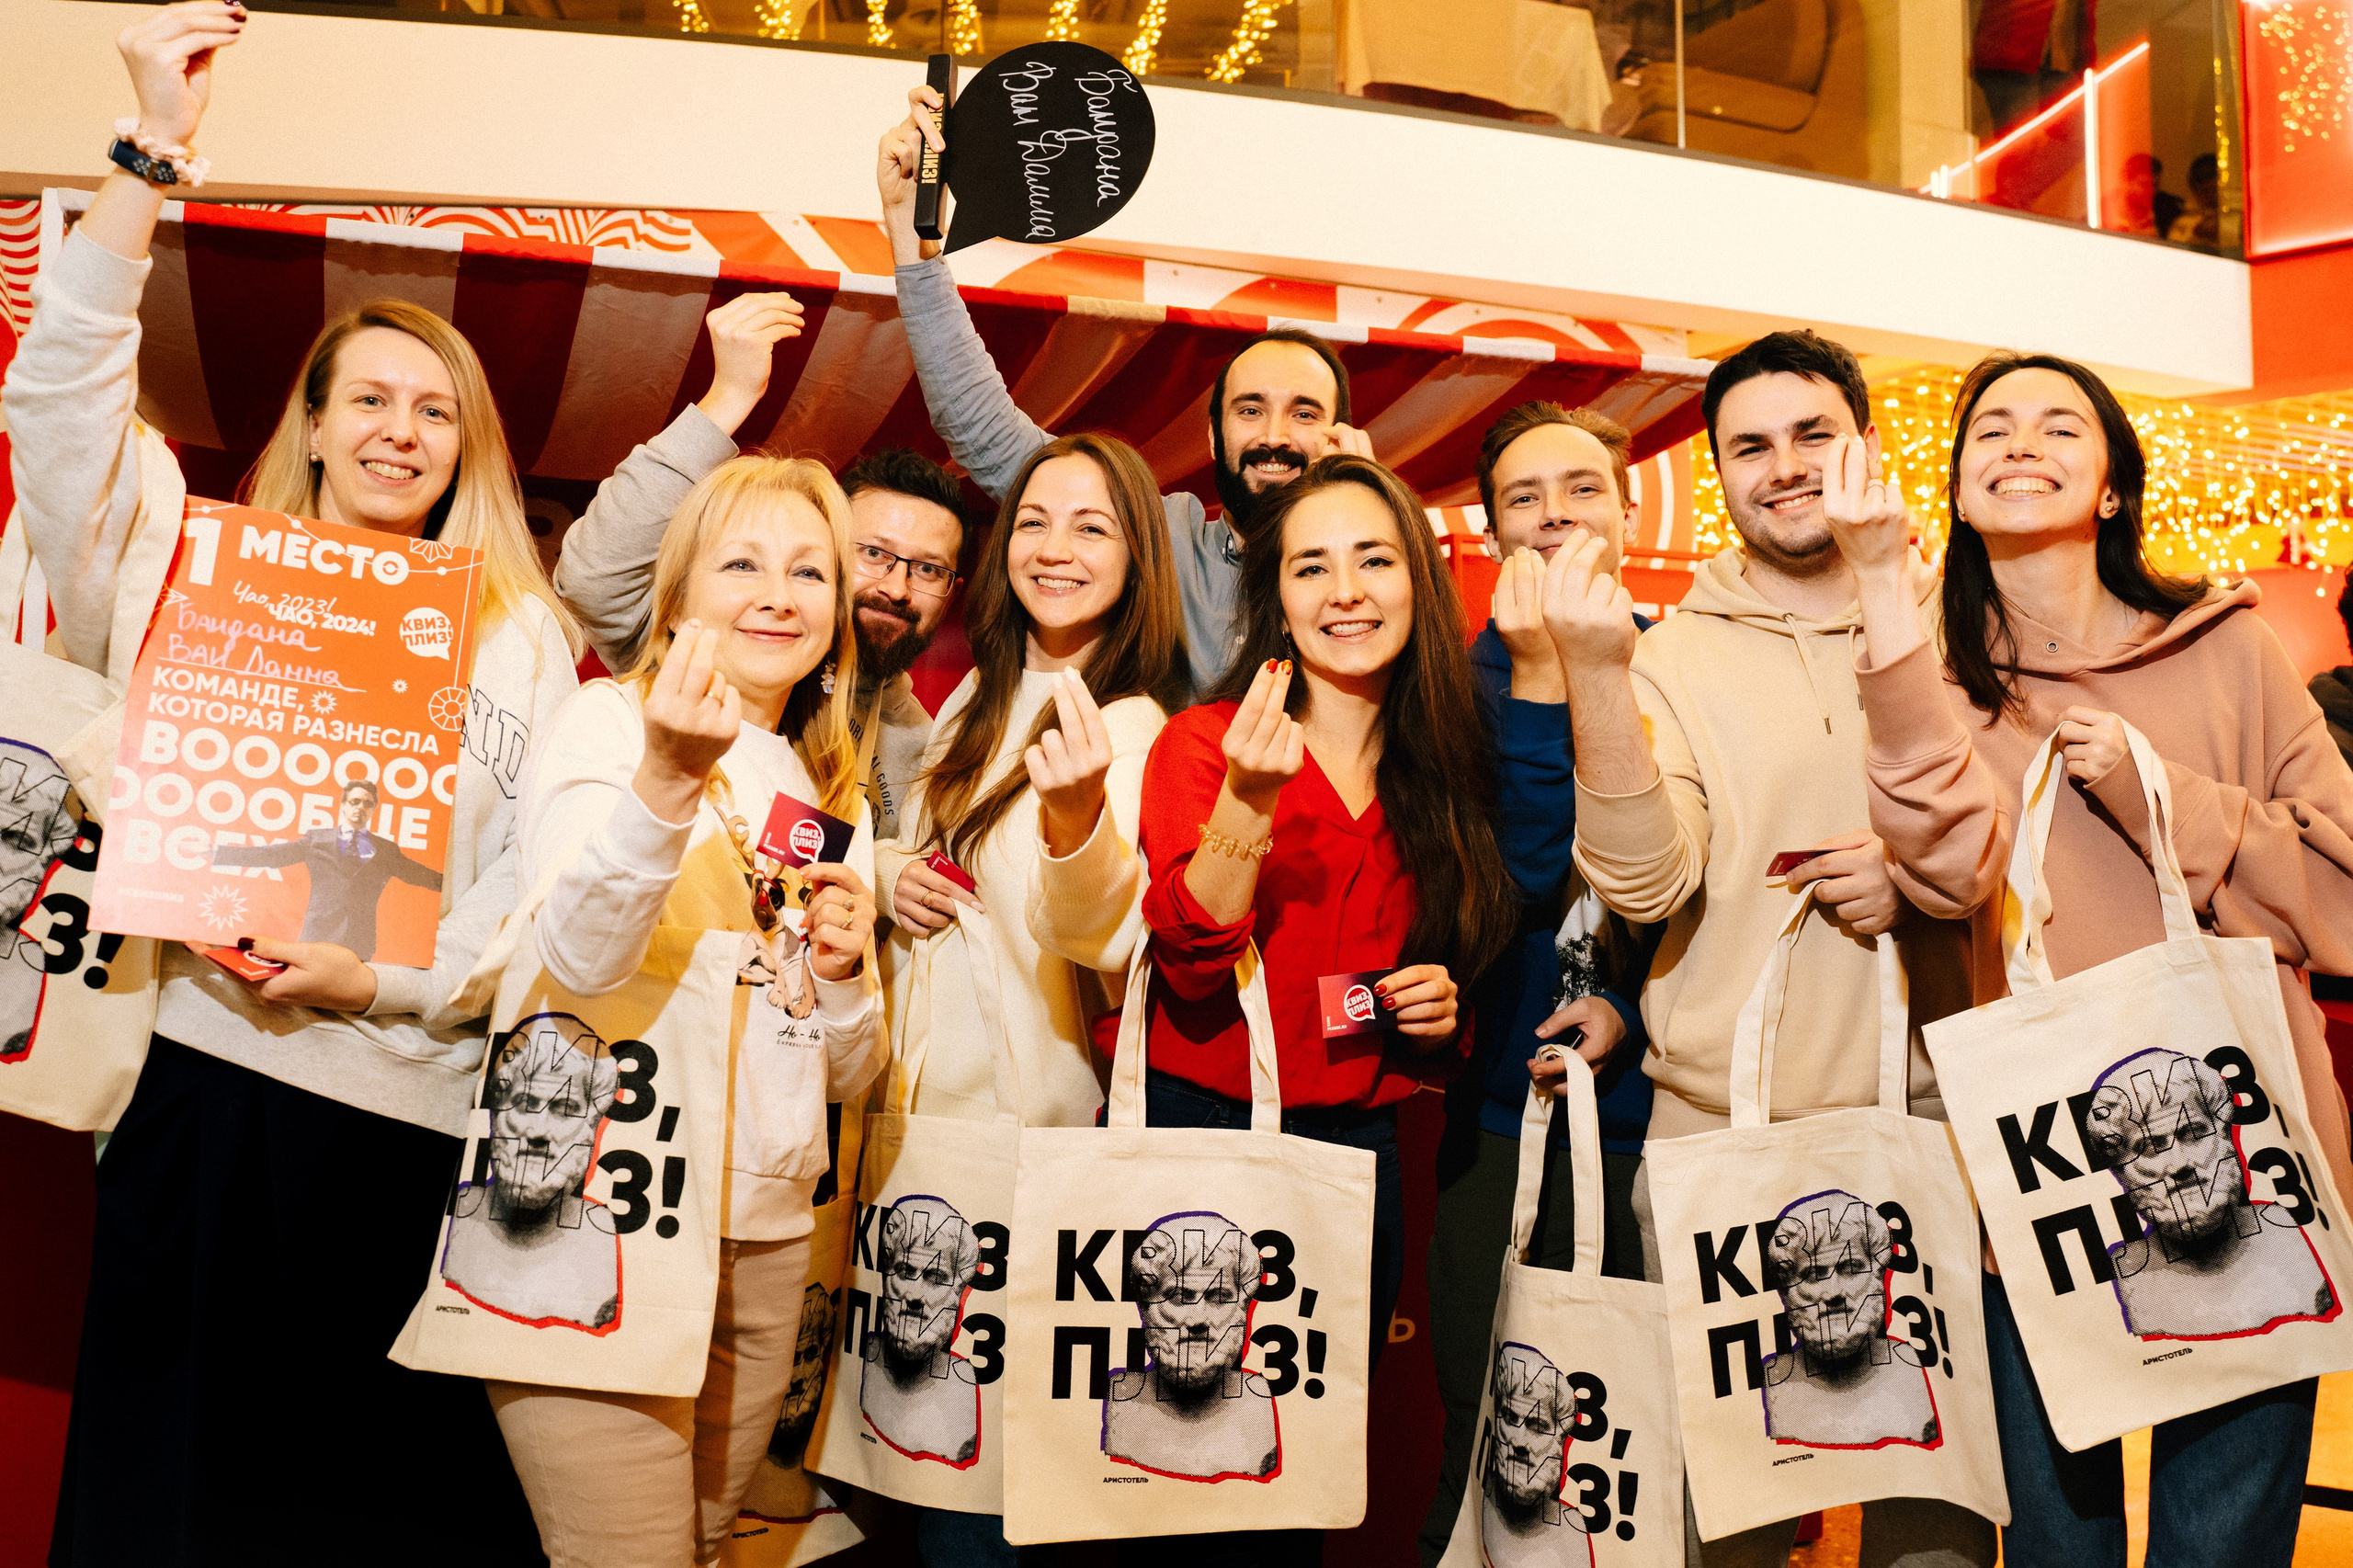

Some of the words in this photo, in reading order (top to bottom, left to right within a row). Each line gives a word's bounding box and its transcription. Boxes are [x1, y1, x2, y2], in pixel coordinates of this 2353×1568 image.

[186, 517, 222, 586] 1
[239, 525, 410, 585] МЕСТО
[233, 580, 270, 608] Чао,
[277, 593, 337, 615] 2023!
[268, 603, 318, 630] ЧАО,
[321, 612, 377, 637] 2024!
[403, 617, 451, 631] КВИЗ,
[402, 631, 452, 646] ПЛИЗ!
[152, 665, 305, 713] КОМАНДЕ,
[147, 691, 284, 733] КОТОРАЯ
[292, 714, 439, 756] РАЗНЕСЛА
[876, 773, 893, 815] GOODS
[1995, 1046, 2290, 1195] КВИЗ,
[2030, 1147, 2330, 1297] ПЛИЗ!
[1055, 1229, 1319, 1319] КВИЗ,
[1693, 1201, 1934, 1304] КВИЗ,
[1051, 1324, 1326, 1402] ПЛИЗ!
[1707, 1295, 1953, 1399] ПЛИЗ!
[2143, 1347, 2193, 1366] АРИСТОТЕЛЬ
[1772, 1453, 1814, 1467] АРИСТОТЕЛЬ
